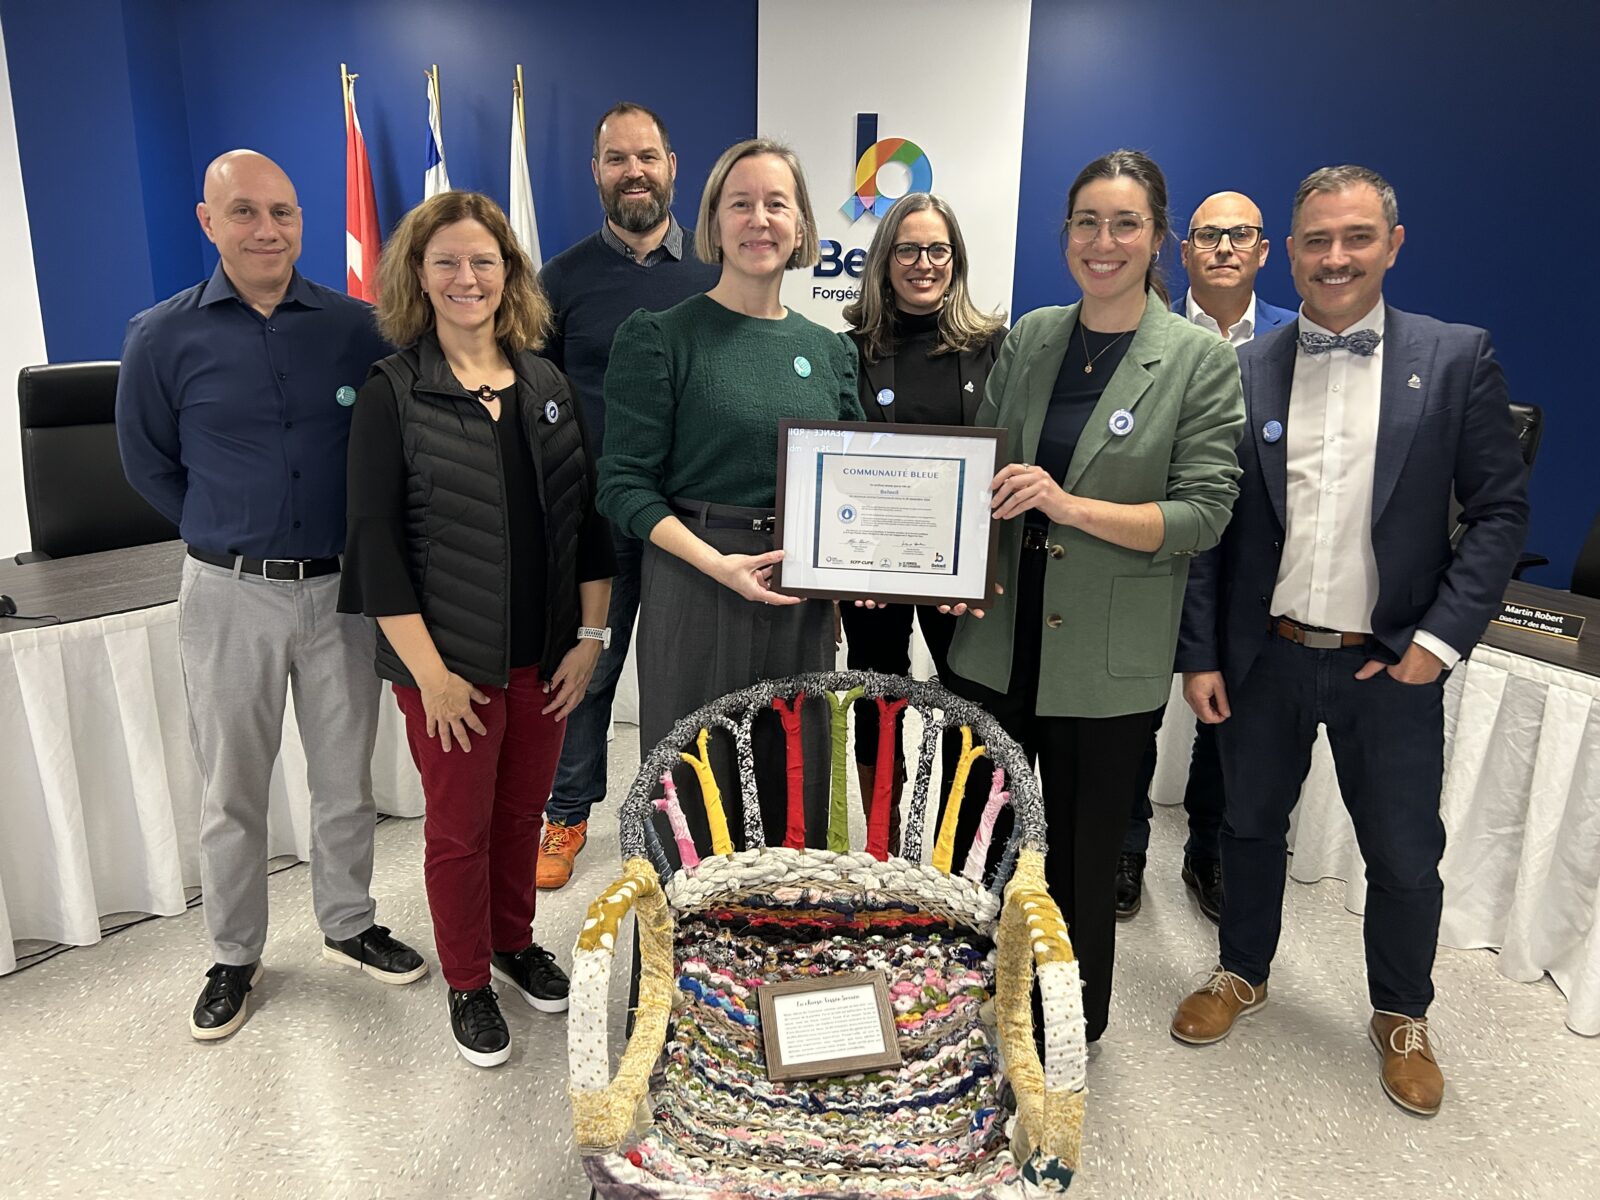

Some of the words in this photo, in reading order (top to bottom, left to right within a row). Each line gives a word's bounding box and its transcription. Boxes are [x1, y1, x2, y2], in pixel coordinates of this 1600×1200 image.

[812, 239, 867, 278] Be
[842, 467, 908, 478] COMMUNAUTÉ
[910, 471, 940, 479] BLEUE
[1505, 605, 1533, 617] Martin
[1534, 611, 1563, 623] Robert
[1499, 615, 1521, 625] District
[1540, 623, 1562, 633] Bourgs
